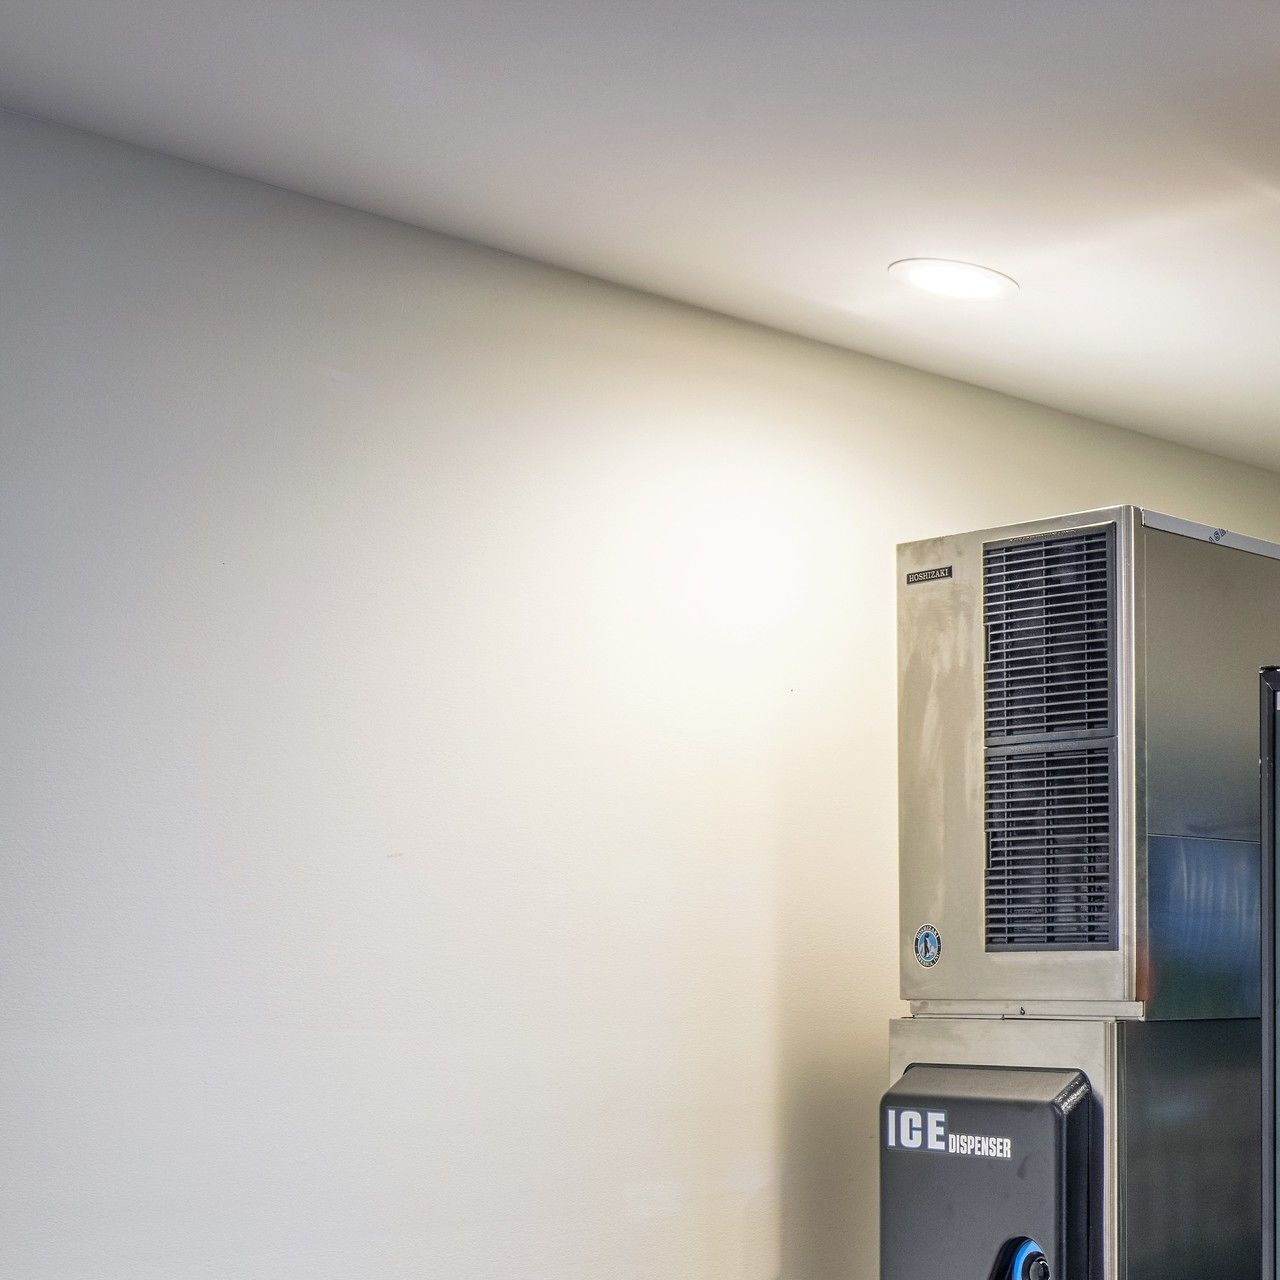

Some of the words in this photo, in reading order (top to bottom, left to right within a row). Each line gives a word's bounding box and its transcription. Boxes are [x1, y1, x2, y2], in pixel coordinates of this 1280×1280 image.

[909, 568, 948, 582] HOSHIZAKI
[888, 1109, 946, 1150] ICE
[949, 1134, 1012, 1158] DISPENSER
